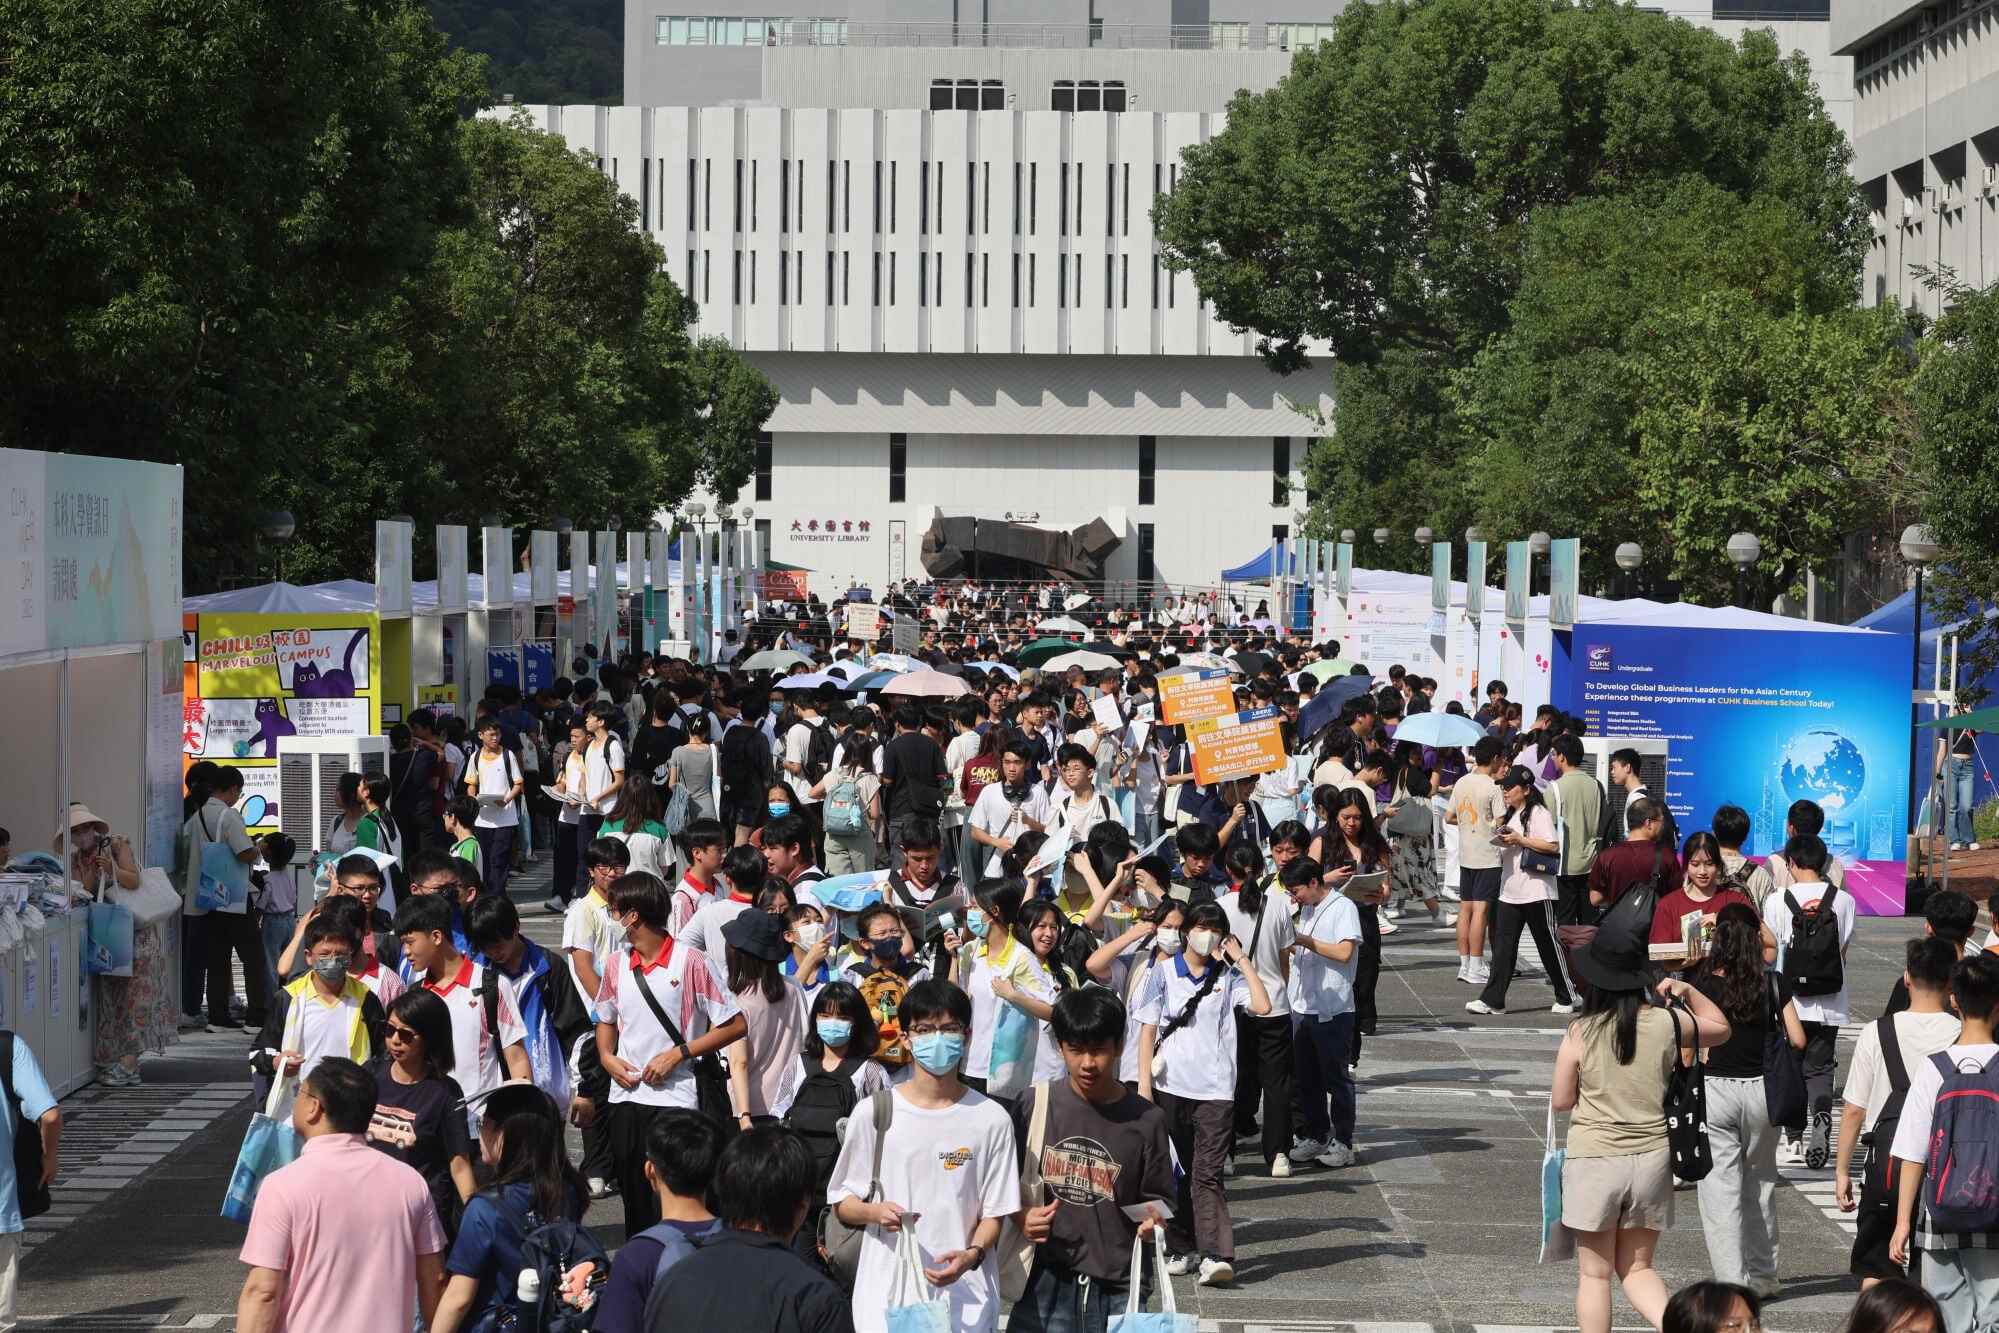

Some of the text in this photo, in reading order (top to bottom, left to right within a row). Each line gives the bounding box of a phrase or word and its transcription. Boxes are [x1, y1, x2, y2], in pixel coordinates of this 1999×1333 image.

[791, 519, 871, 532] 大學圖書館
[202, 646, 331, 672] MARVELOUS CAMPUS
[1584, 682, 1811, 698] To Develop Global Business Leaders for the Asian Century
[1584, 693, 1834, 709] Experience these programmes at CUHK Business School Today!
[210, 728, 230, 737] Largest
[1668, 1116, 1678, 1128] 9
[1685, 1112, 1693, 1124] 1
